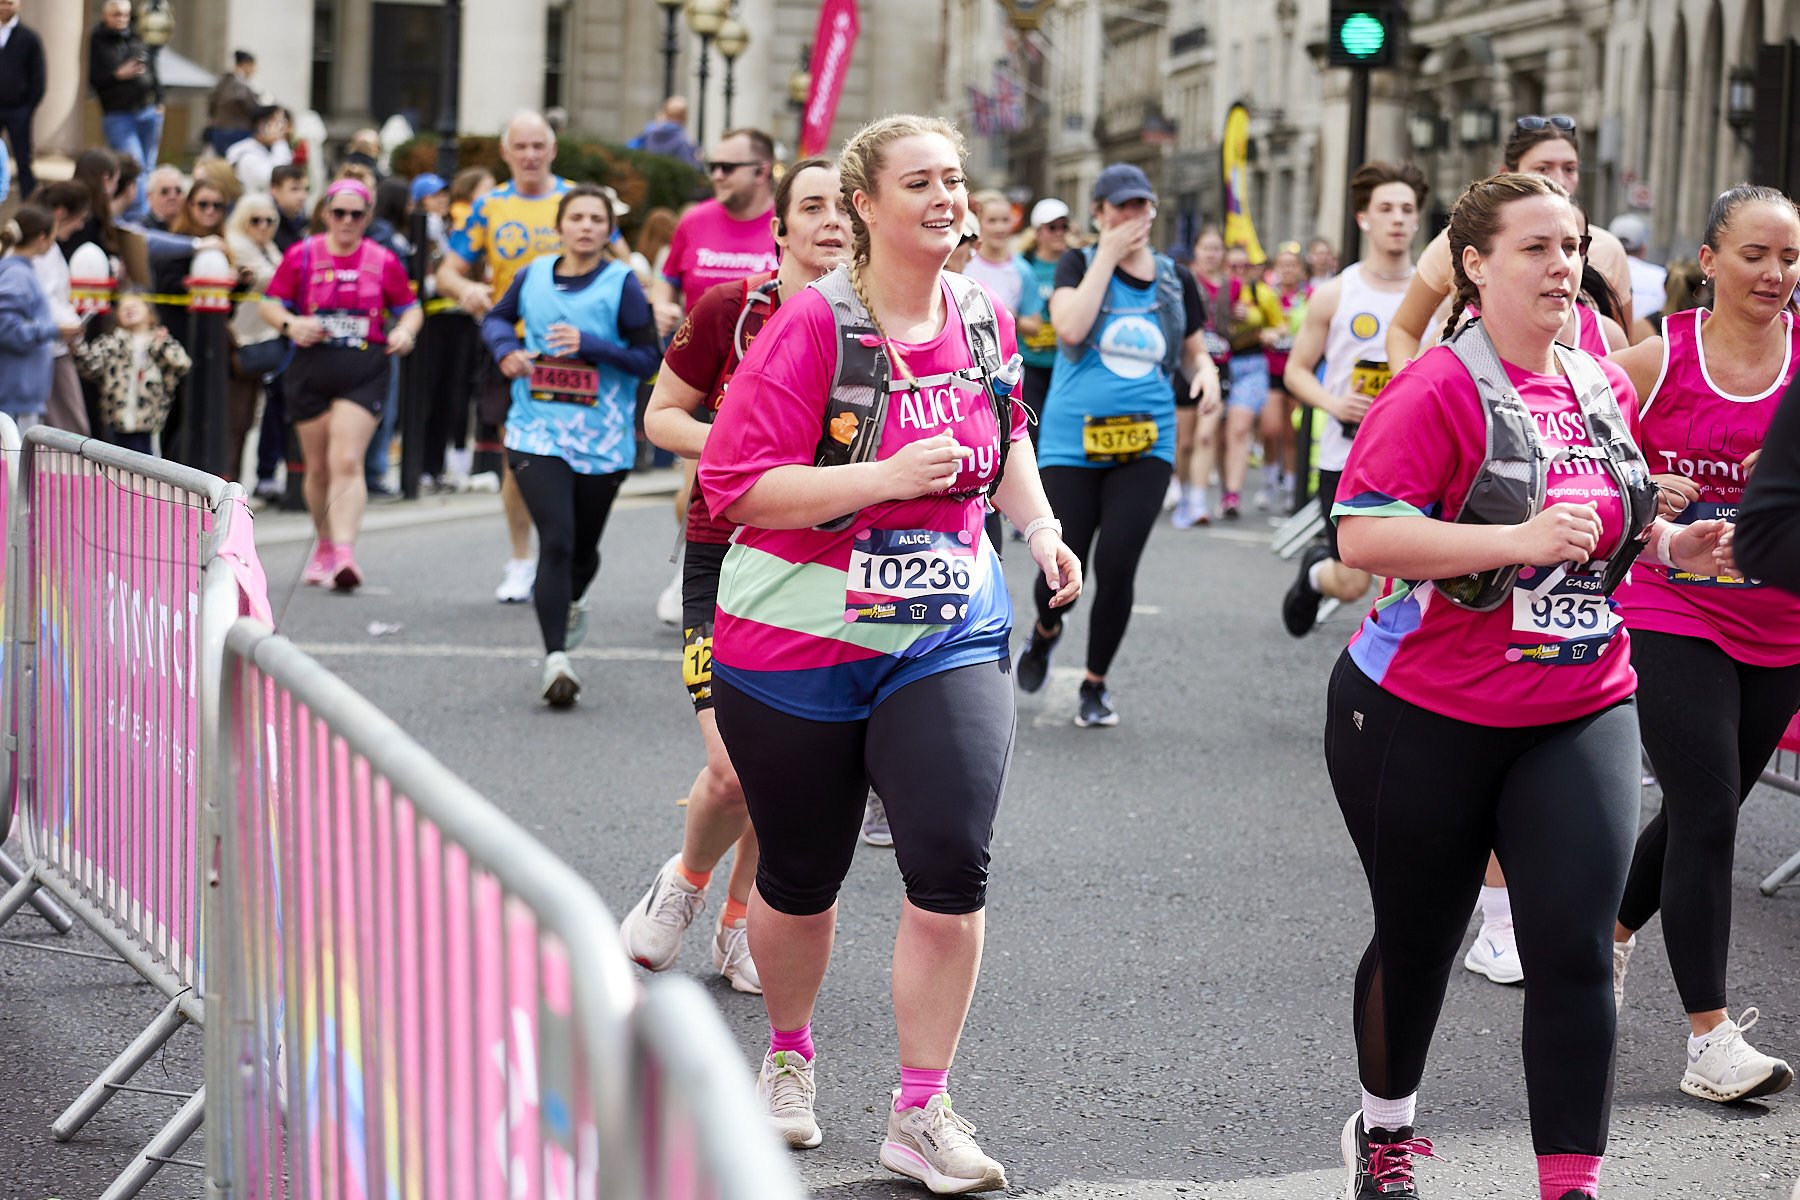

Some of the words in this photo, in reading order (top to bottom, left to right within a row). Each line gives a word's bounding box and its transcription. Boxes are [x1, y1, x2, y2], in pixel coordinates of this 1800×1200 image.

[900, 385, 965, 429] ALICE
[1590, 486, 1608, 497] and
[1716, 508, 1740, 517] LUC
[898, 534, 932, 545] ALICE
[860, 557, 970, 590] 10236
[1565, 578, 1602, 591] CASSI
[1531, 596, 1609, 629] 935
